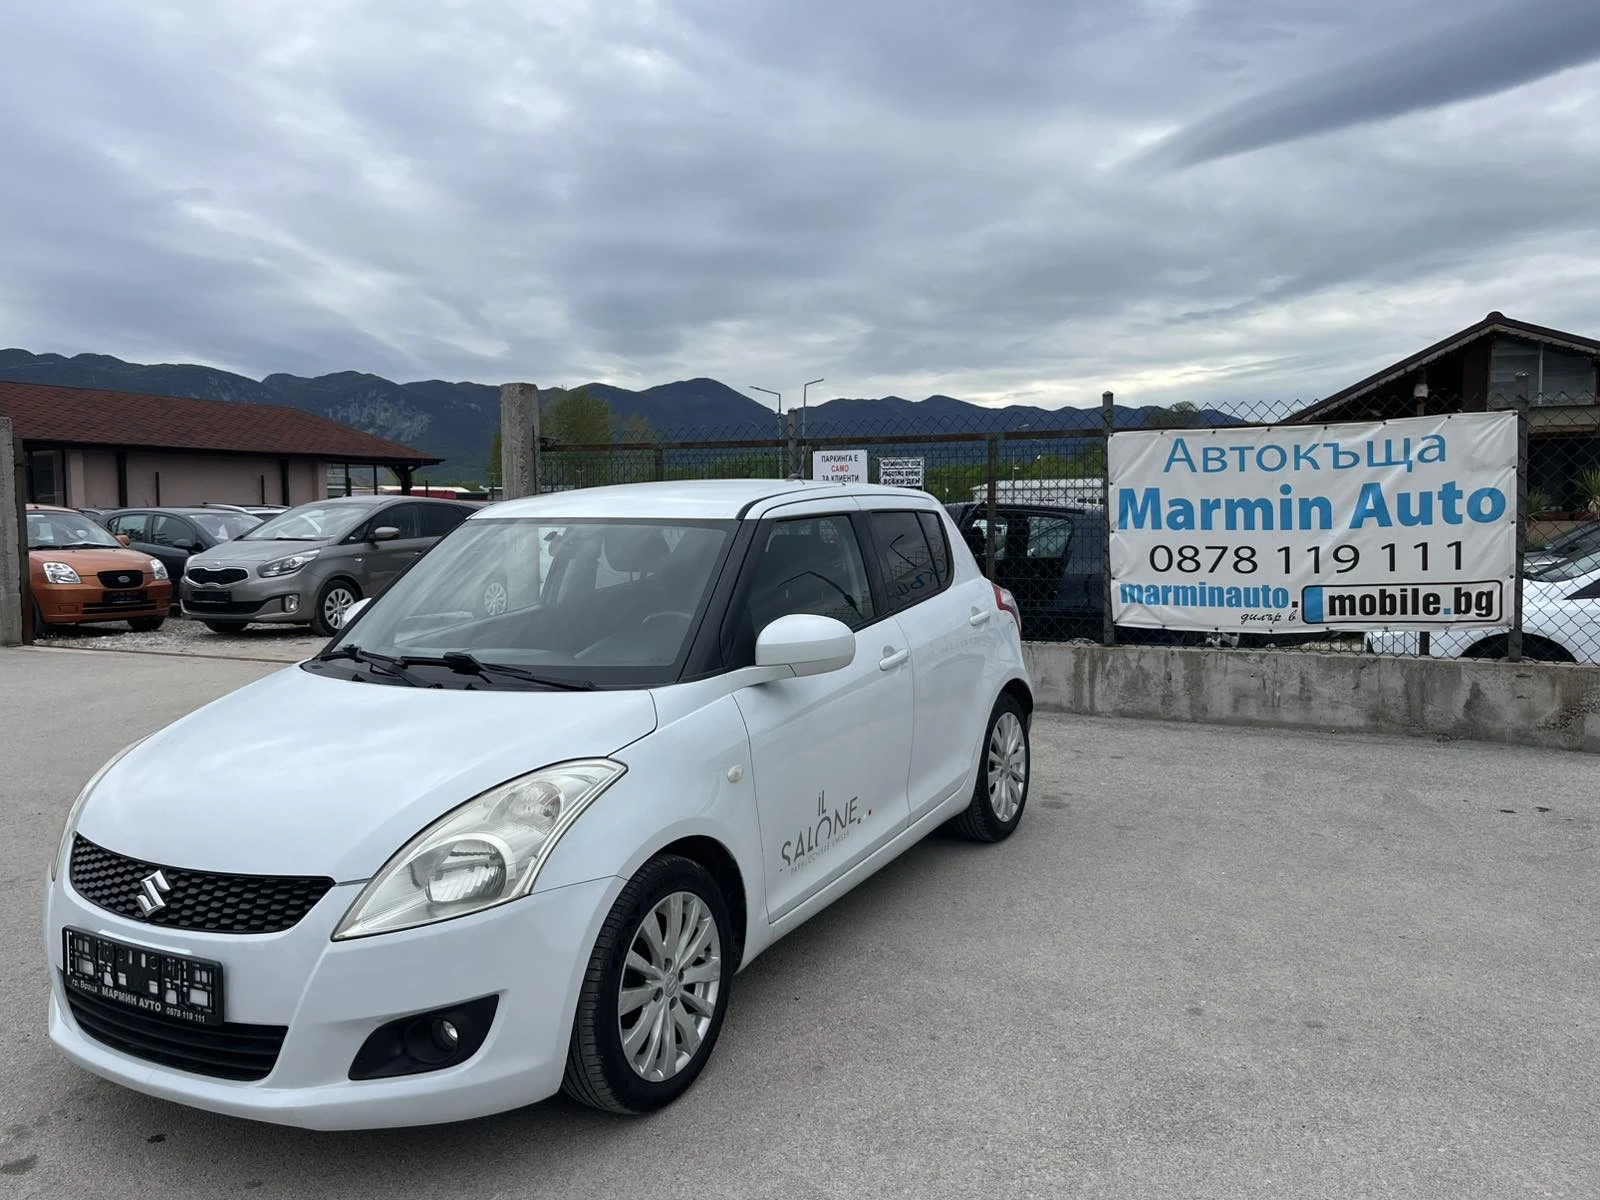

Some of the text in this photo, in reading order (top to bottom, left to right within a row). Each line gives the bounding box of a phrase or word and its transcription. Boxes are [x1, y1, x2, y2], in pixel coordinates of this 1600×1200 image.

[821, 454, 859, 463] ПАРКИНГА Е
[831, 465, 849, 473] САМО
[1163, 433, 1447, 473] Автокъща
[1118, 480, 1507, 531] Marmin Auto
[1149, 540, 1463, 574] 0878 119 111
[1328, 586, 1494, 617] mobile.bg
[102, 986, 137, 1006] МАРМИН
[138, 997, 162, 1013] АУТО
[194, 1012, 206, 1024] 111
